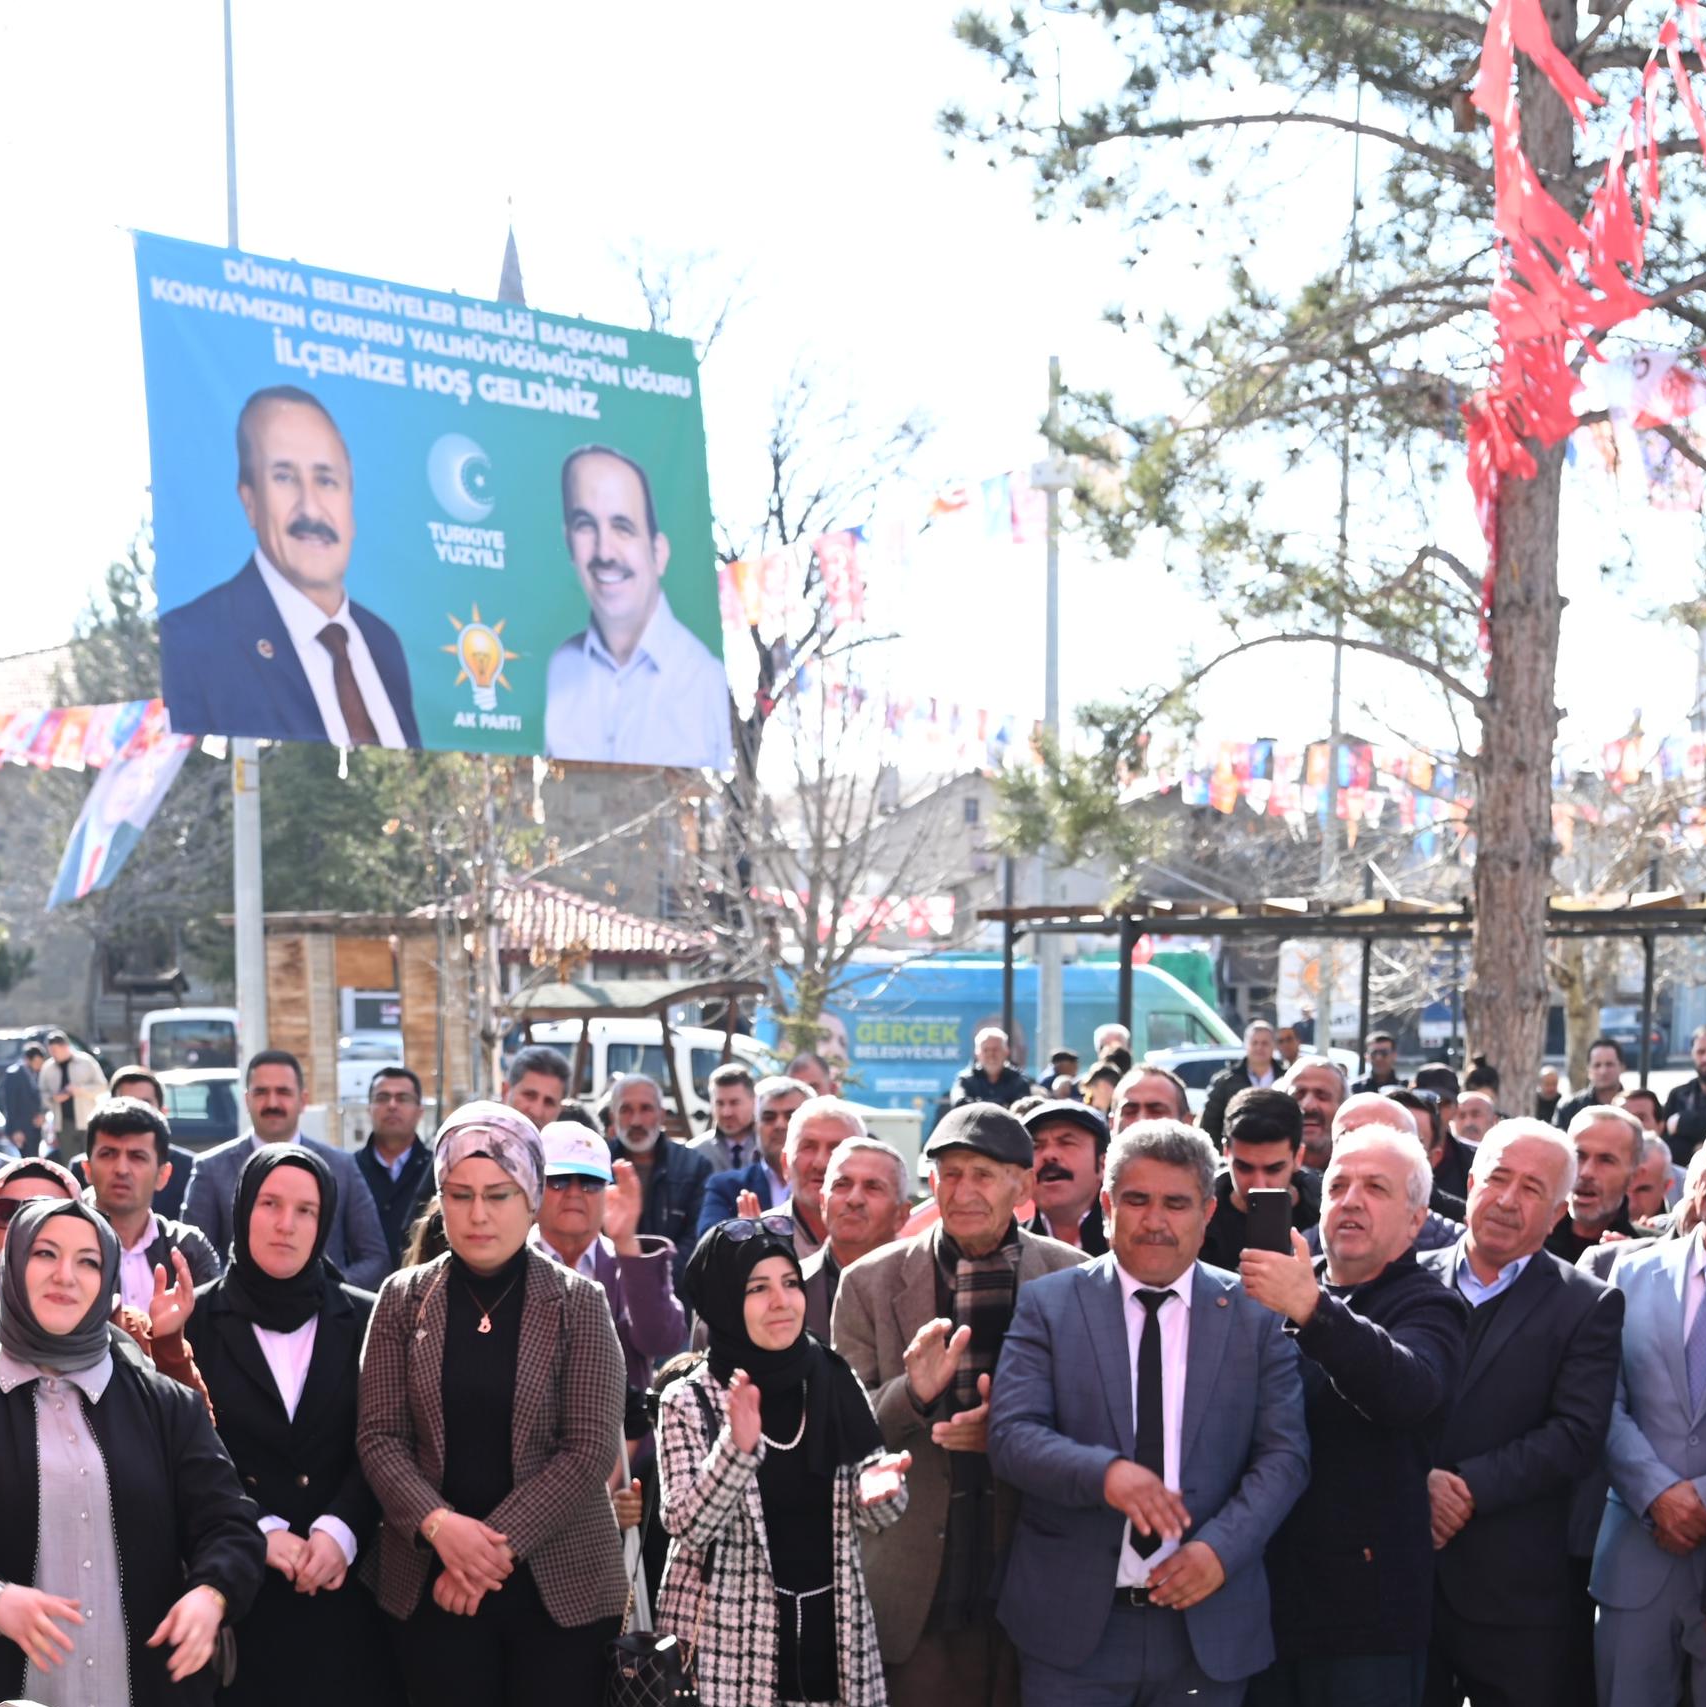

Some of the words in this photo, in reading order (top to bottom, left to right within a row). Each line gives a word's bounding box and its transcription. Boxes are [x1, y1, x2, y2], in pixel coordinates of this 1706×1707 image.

[150, 276, 307, 329] KONYA'MIZIN
[310, 308, 405, 348] GURURU
[622, 364, 692, 399] UĞURU
[222, 256, 308, 297] DÜNYA
[311, 276, 457, 327] BELEDİYELER
[539, 321, 628, 359] BAŞKANI
[272, 326, 408, 387] İLÇEMİZE
[411, 360, 473, 406] HOŞ
[477, 373, 601, 420] GELDİNİZ
[453, 711, 476, 728] AK
[856, 1021, 961, 1047] GERÇEK
